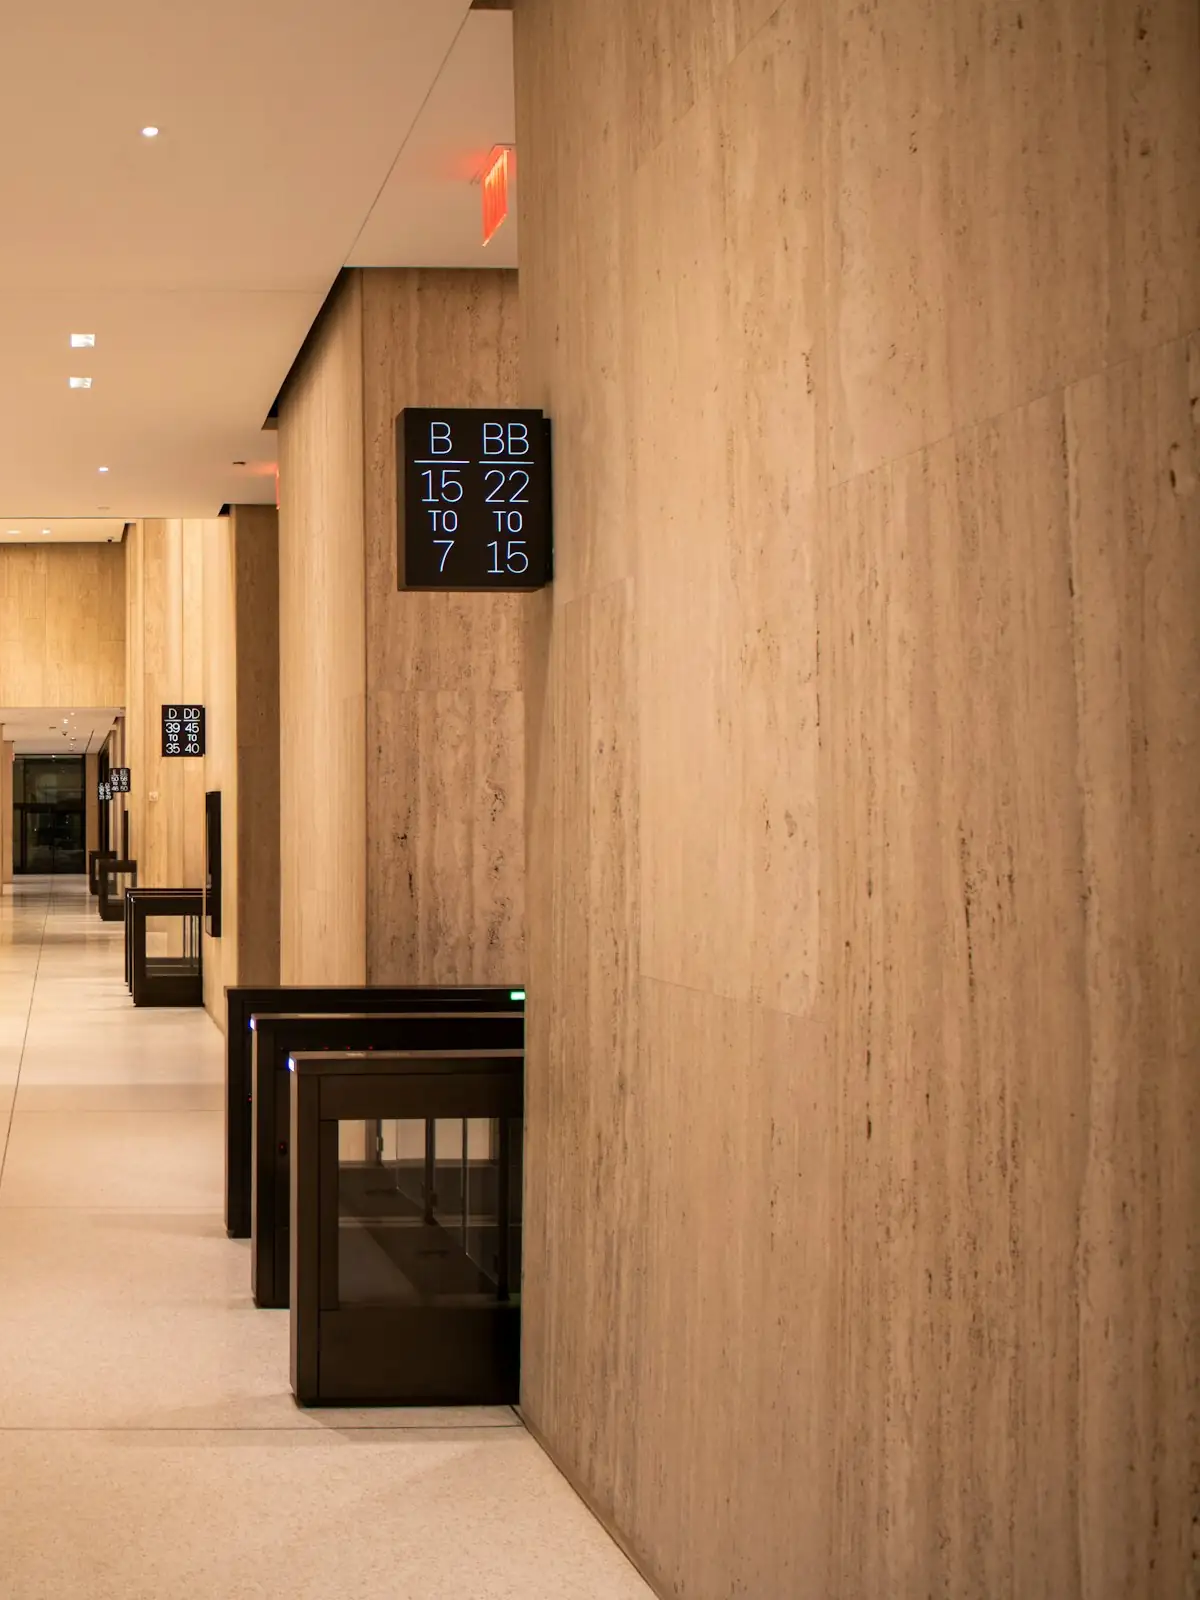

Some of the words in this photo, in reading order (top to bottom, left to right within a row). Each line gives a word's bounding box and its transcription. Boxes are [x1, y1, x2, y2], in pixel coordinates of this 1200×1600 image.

[431, 422, 452, 454] B
[483, 423, 529, 455] BB
[421, 470, 464, 502] 15
[485, 470, 529, 502] 22
[428, 510, 457, 532] TO
[493, 511, 522, 533] TO
[433, 540, 455, 573] 7
[487, 541, 528, 574] 15
[168, 708, 177, 719] D
[184, 708, 200, 719] DD
[166, 723, 180, 733] 39
[185, 723, 199, 733] 45
[168, 734, 178, 742] TO
[187, 734, 197, 742] TO
[166, 743, 180, 753] 35
[185, 743, 199, 753] 40
